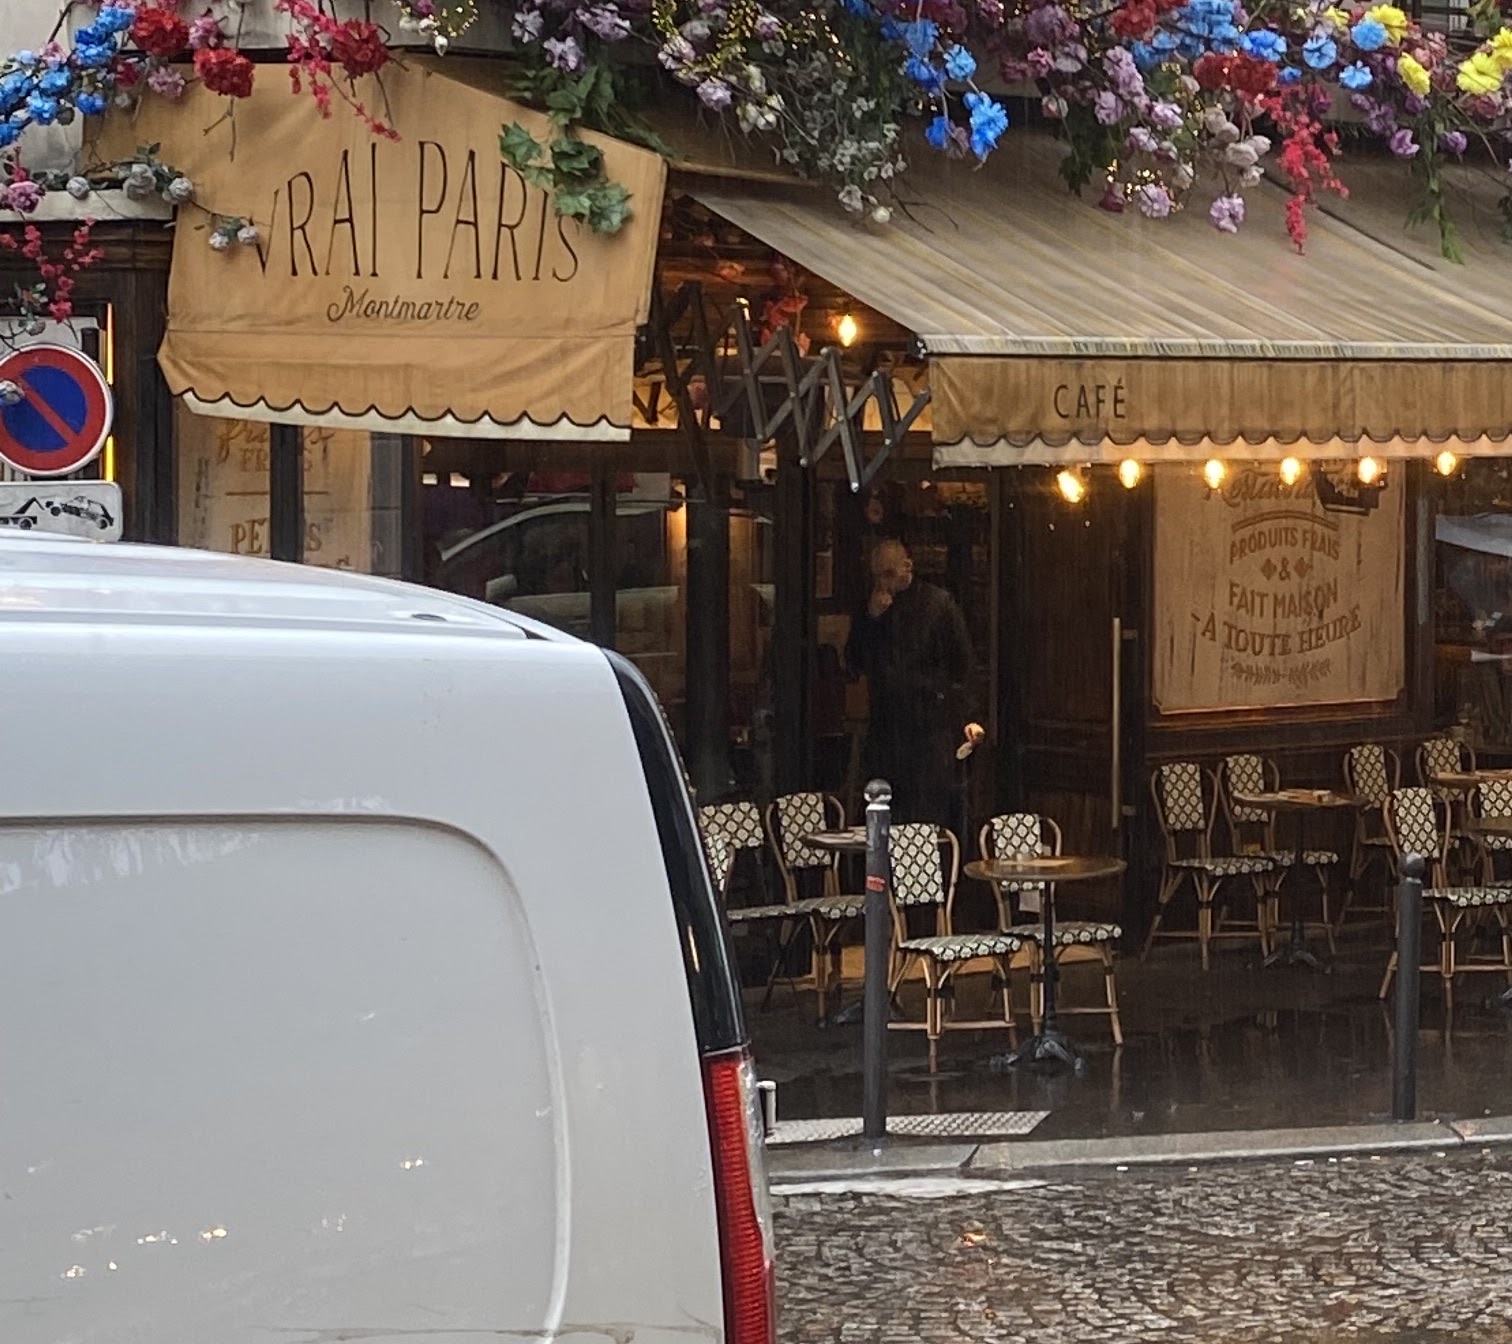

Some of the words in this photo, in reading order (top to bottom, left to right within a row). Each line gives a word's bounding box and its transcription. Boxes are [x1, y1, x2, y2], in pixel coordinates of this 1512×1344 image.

[249, 142, 378, 278] VRAI
[416, 140, 580, 282] PARIS
[326, 284, 481, 323] Montmartre
[1053, 377, 1127, 420] CAFÉ
[1229, 527, 1299, 565] PRODUITS
[1302, 529, 1340, 561] FRAIS
[1278, 557, 1291, 581] &
[1229, 578, 1269, 619] FAIT
[1272, 577, 1338, 622] MAISON
[1222, 620, 1292, 657] TOUTE
[1297, 604, 1362, 654] HEURE
